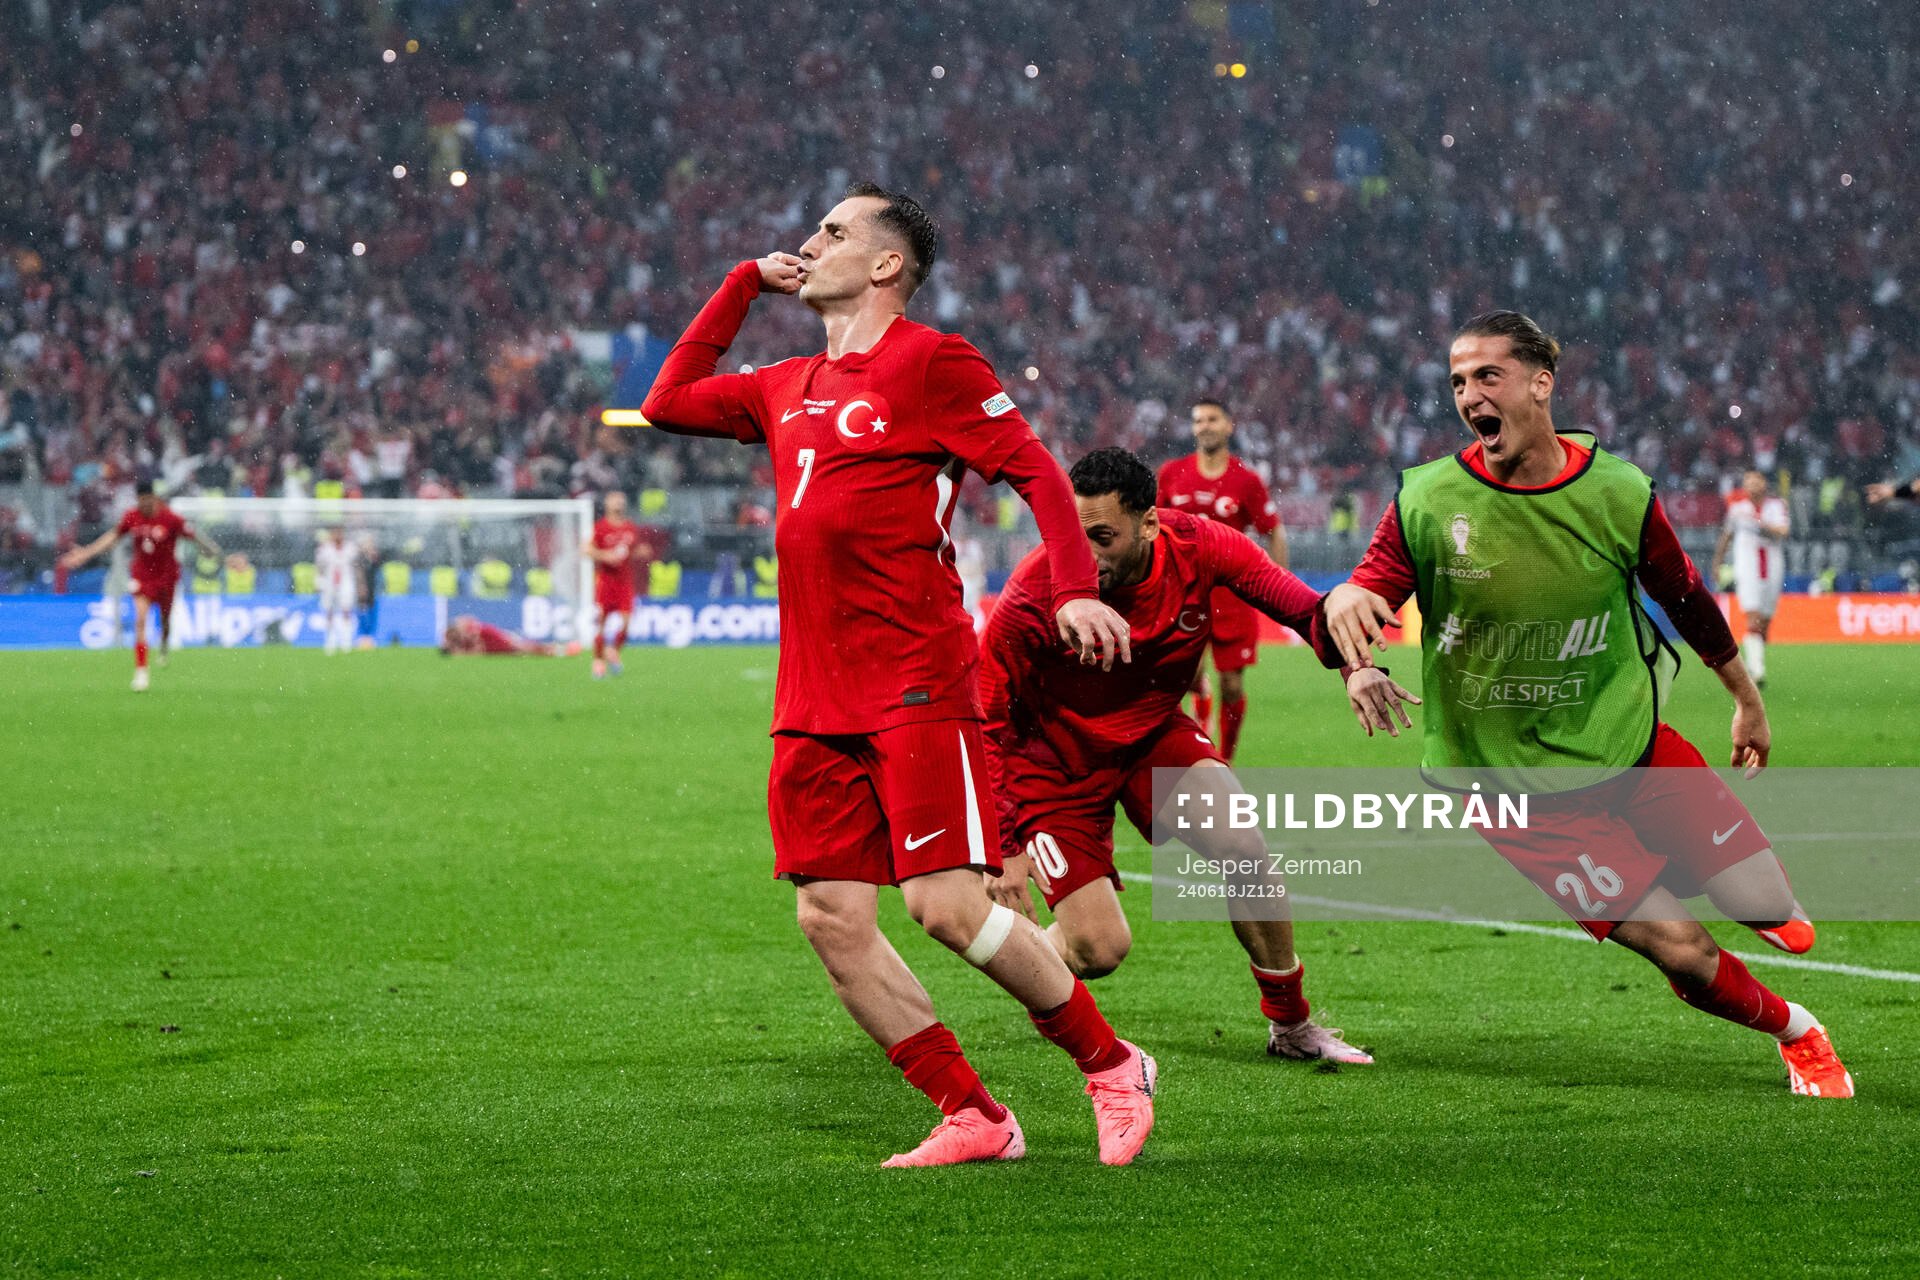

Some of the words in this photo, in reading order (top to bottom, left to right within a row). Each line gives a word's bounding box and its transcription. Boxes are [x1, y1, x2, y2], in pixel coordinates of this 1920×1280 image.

[791, 448, 816, 509] 7
[1437, 611, 1610, 663] #FOOTBALL
[1838, 596, 1920, 636] tren
[1488, 679, 1585, 702] RESPECT
[1026, 832, 1069, 886] 10
[1555, 854, 1624, 918] 26
